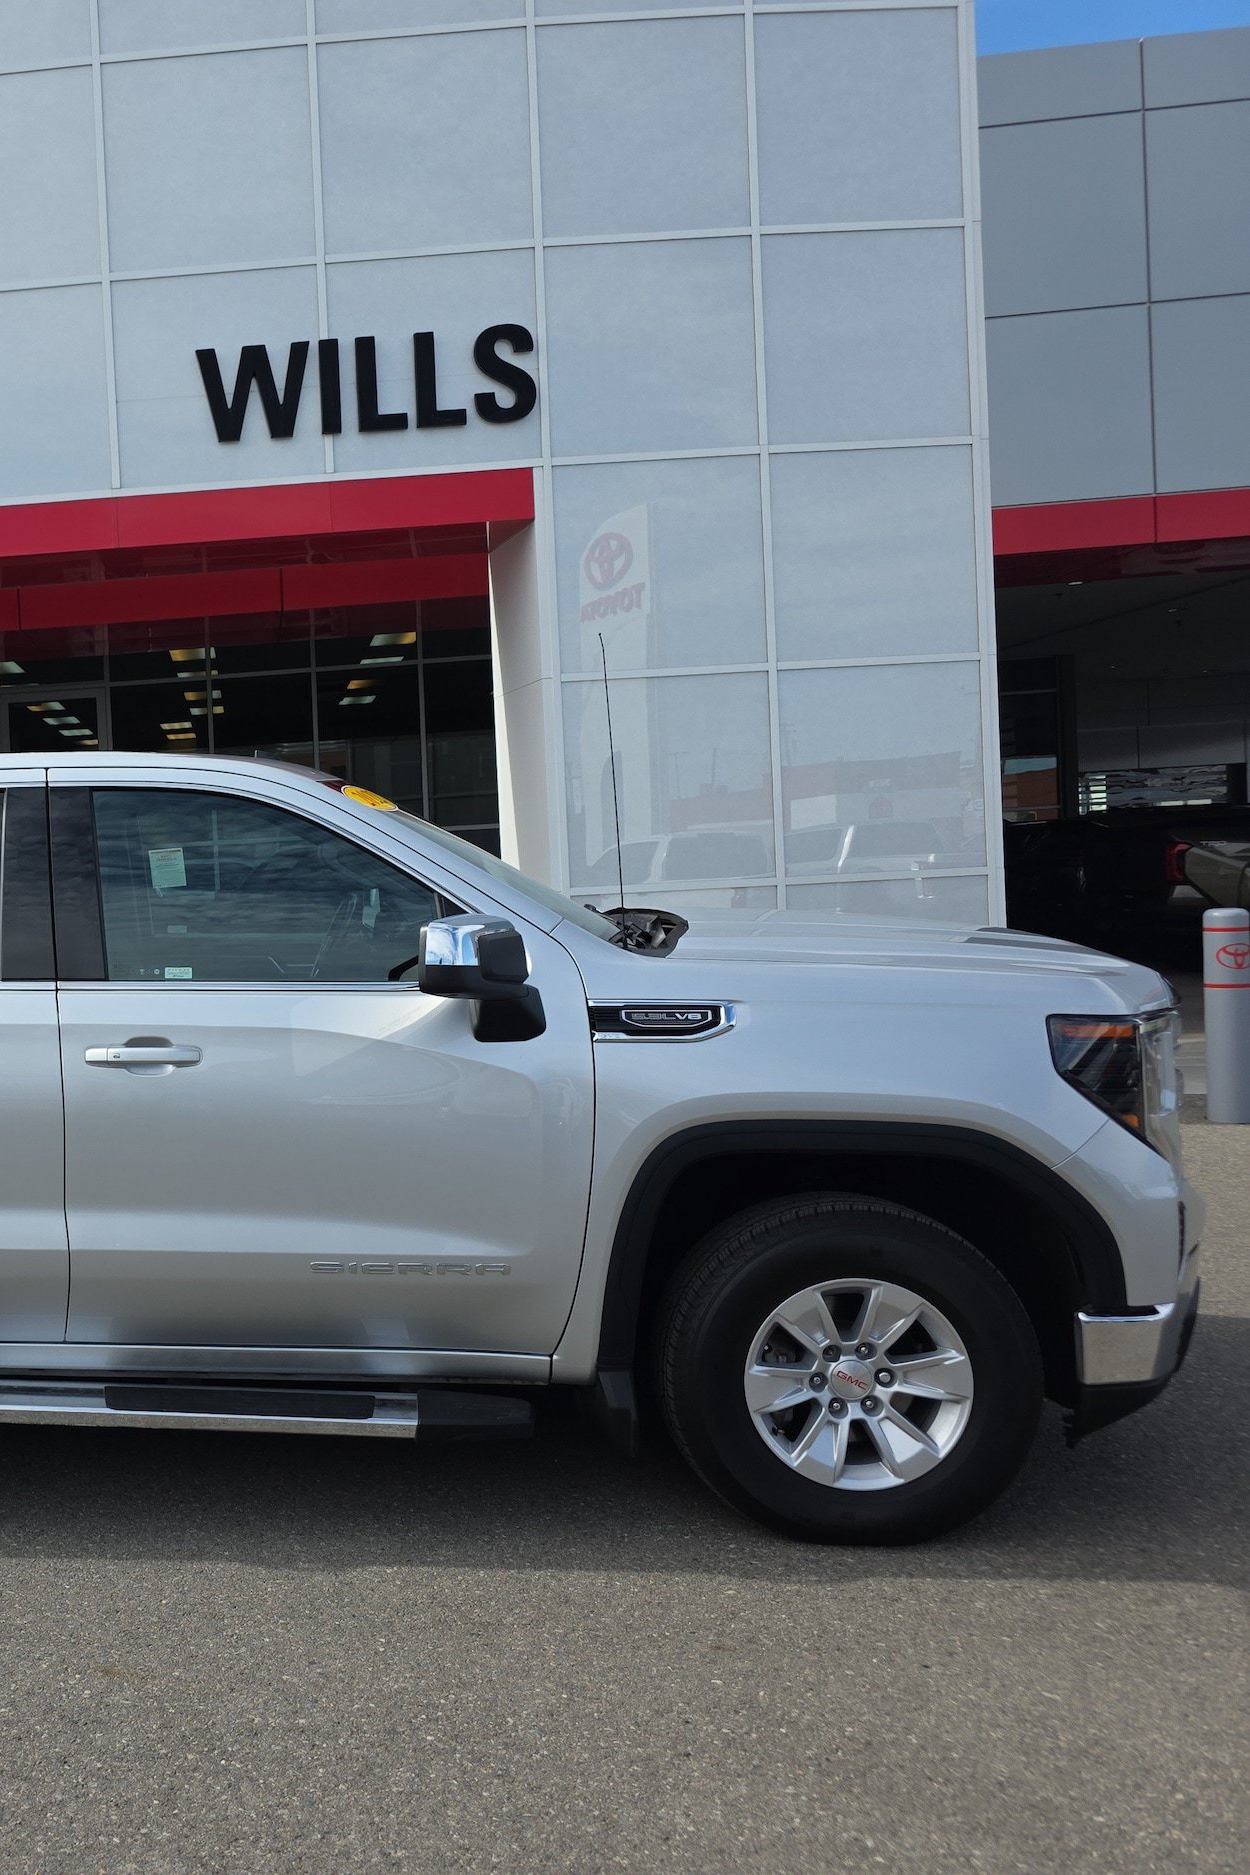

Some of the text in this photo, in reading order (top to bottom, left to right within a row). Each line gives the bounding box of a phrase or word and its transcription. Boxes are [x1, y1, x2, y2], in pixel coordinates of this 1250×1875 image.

[195, 323, 537, 443] WILLS
[309, 1261, 511, 1276] SIERRA
[836, 1370, 869, 1391] GMC
